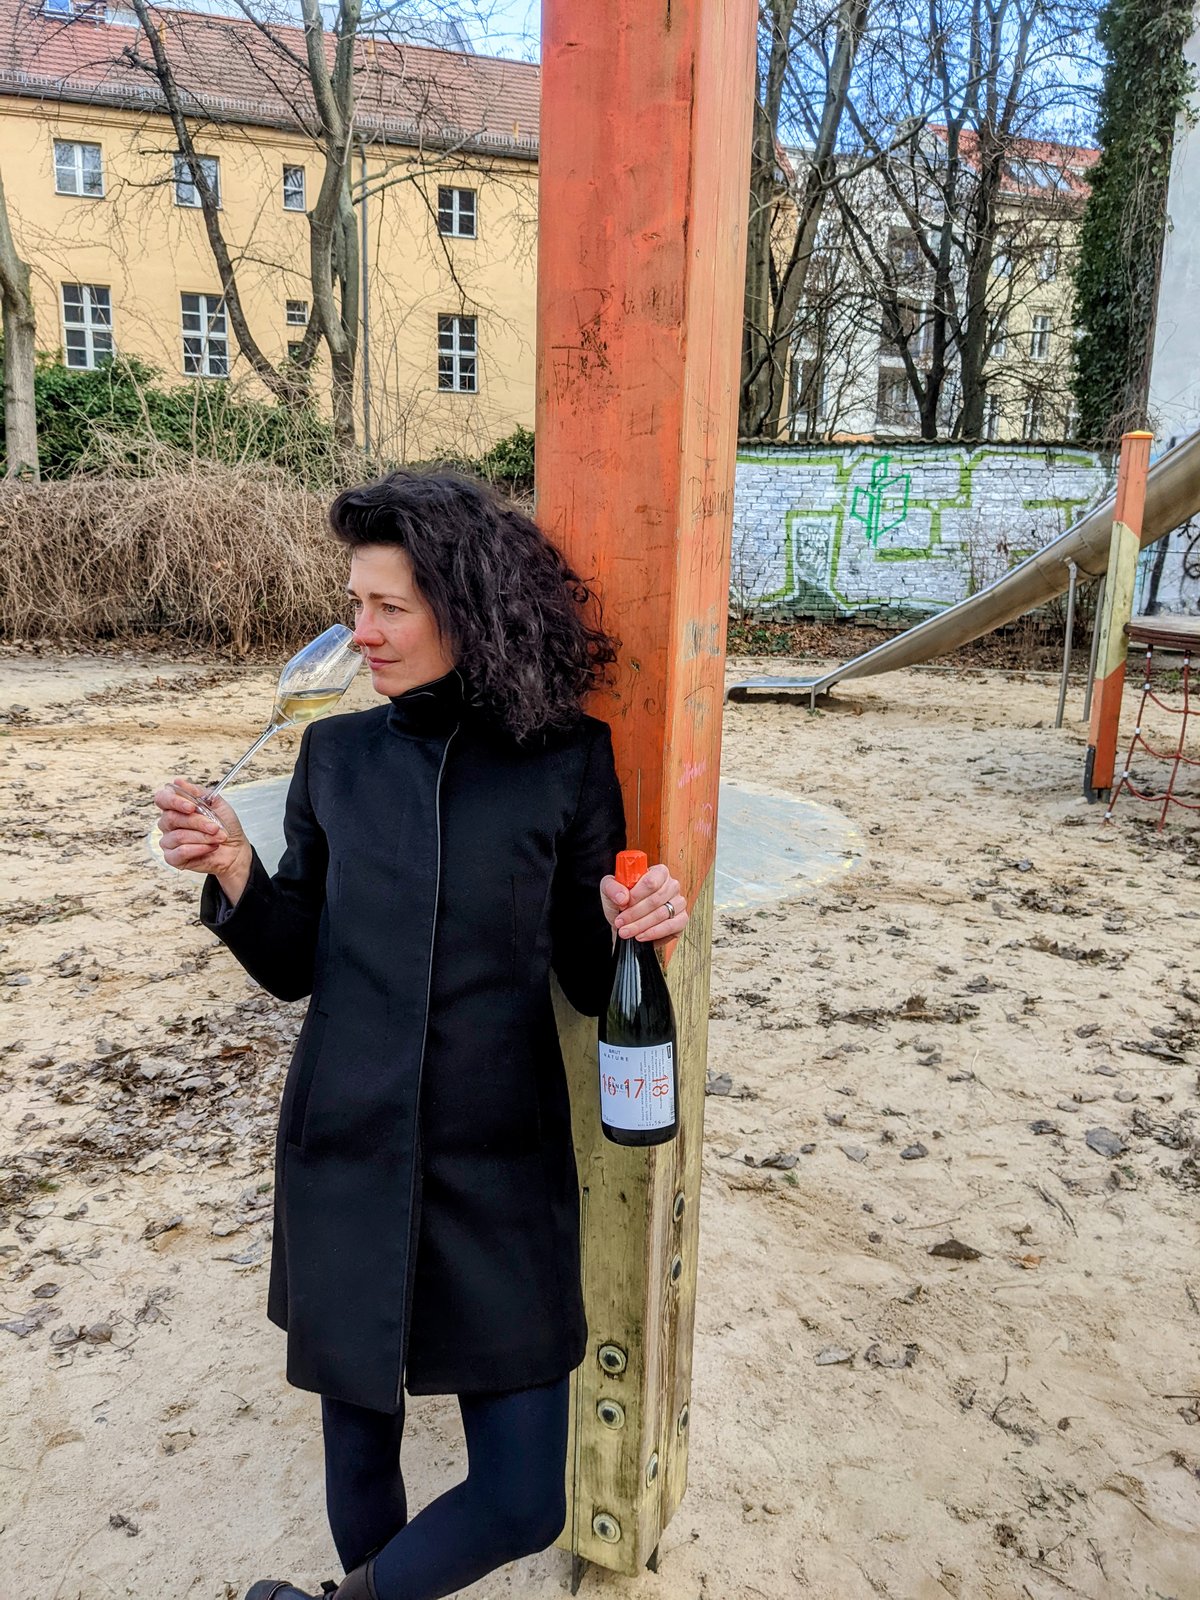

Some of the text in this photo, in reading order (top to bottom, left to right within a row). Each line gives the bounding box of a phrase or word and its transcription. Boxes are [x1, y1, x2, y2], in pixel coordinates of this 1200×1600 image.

[603, 1053, 629, 1062] NATURE
[602, 1073, 617, 1096] 16
[624, 1078, 645, 1099] 17
[652, 1074, 669, 1097] 18
